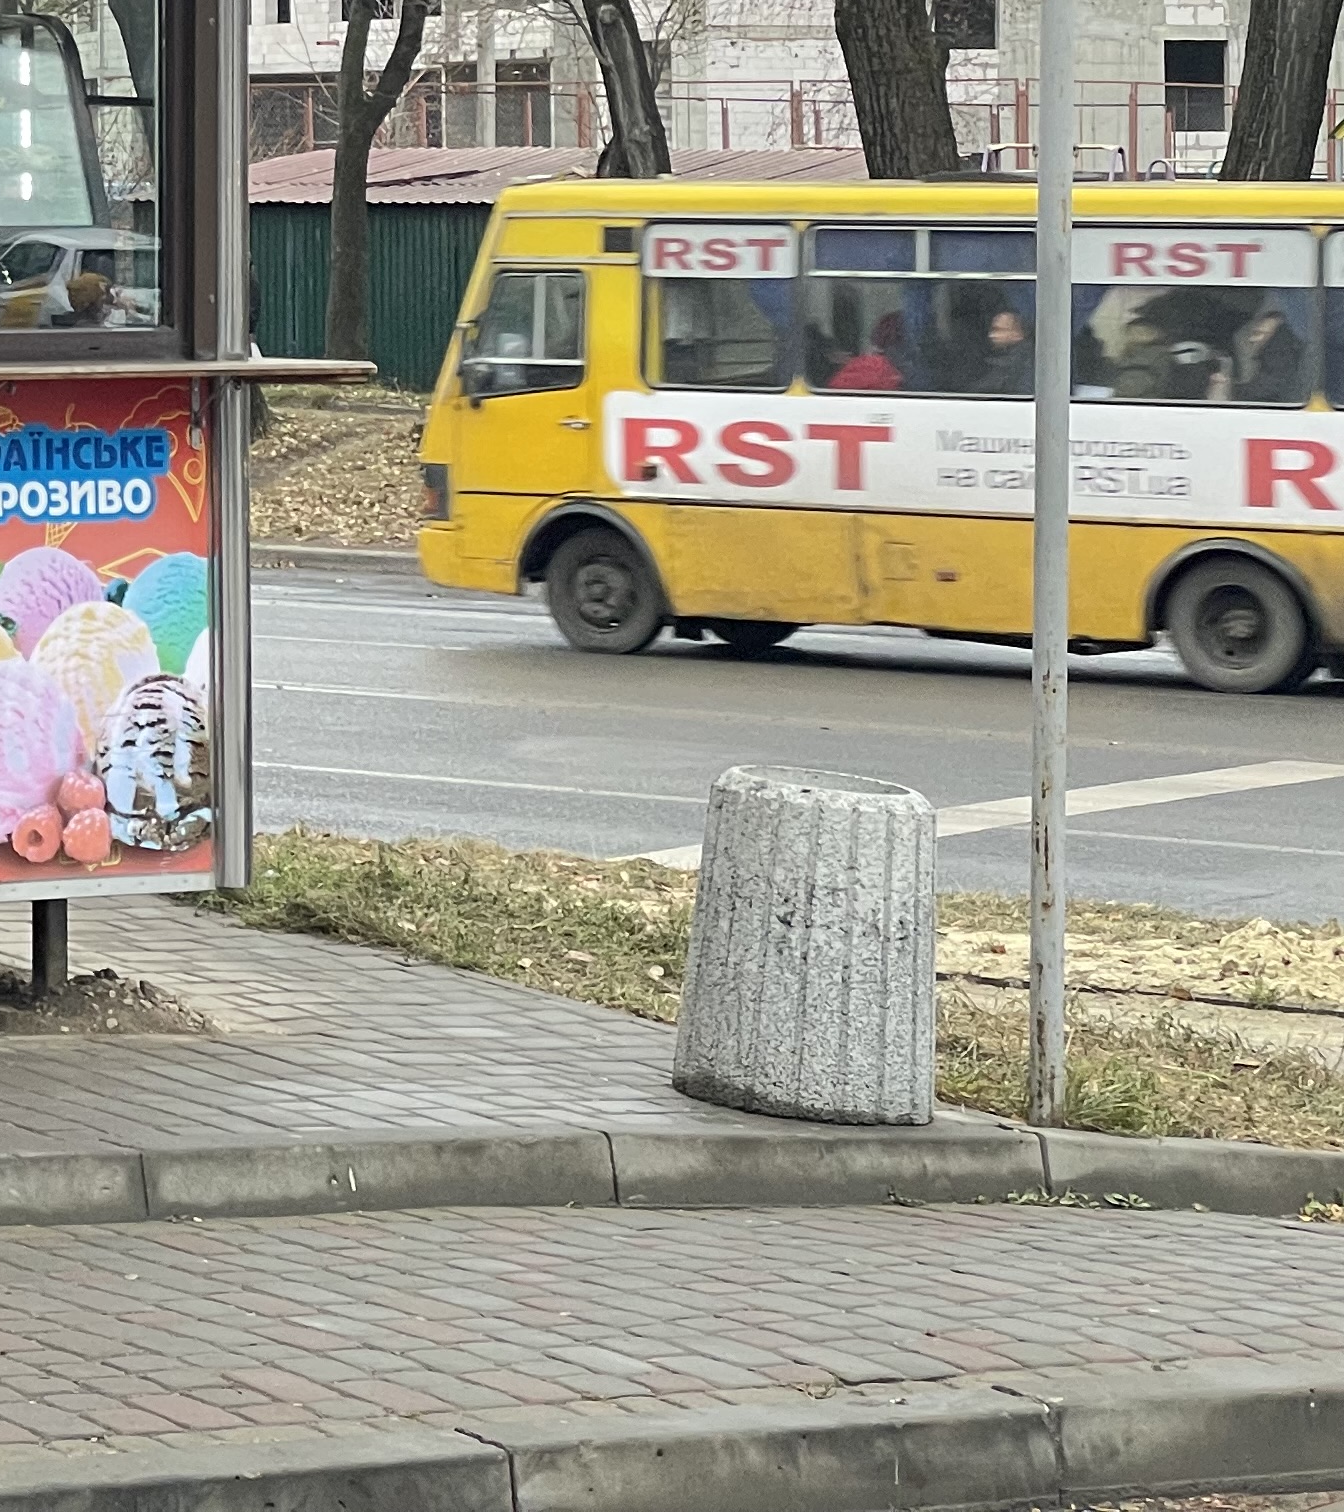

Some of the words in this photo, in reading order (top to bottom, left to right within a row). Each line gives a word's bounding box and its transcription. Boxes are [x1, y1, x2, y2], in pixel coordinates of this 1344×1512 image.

[654, 237, 786, 271] RST
[1113, 242, 1261, 278] RST
[623, 417, 894, 491] RST
[936, 430, 1035, 454] Машин
